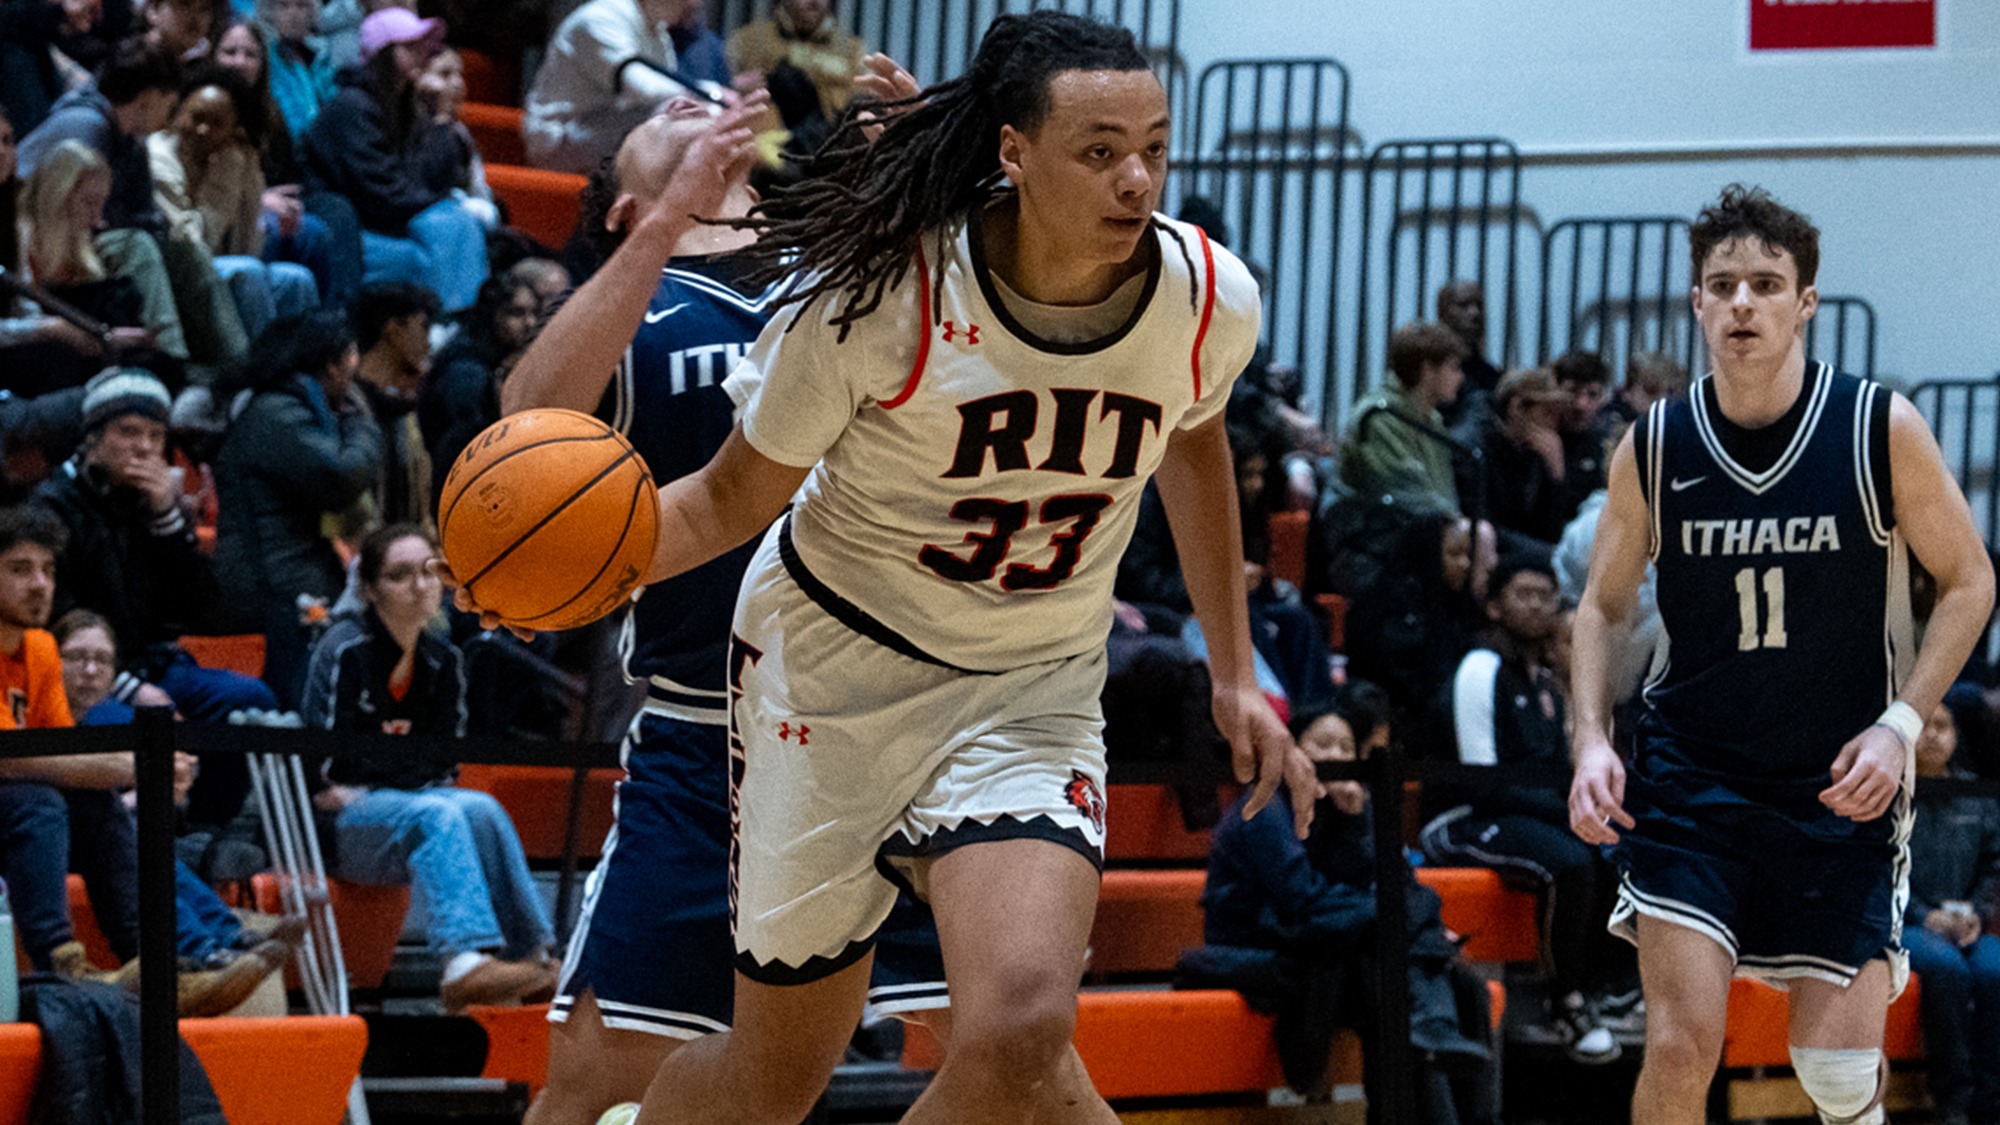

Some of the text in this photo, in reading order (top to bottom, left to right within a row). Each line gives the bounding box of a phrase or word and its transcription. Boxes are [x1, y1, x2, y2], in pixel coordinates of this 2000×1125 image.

[939, 388, 1163, 479] RIT
[918, 493, 1114, 592] 33
[1681, 515, 1841, 555] ITHACA
[1735, 566, 1787, 650] 11
